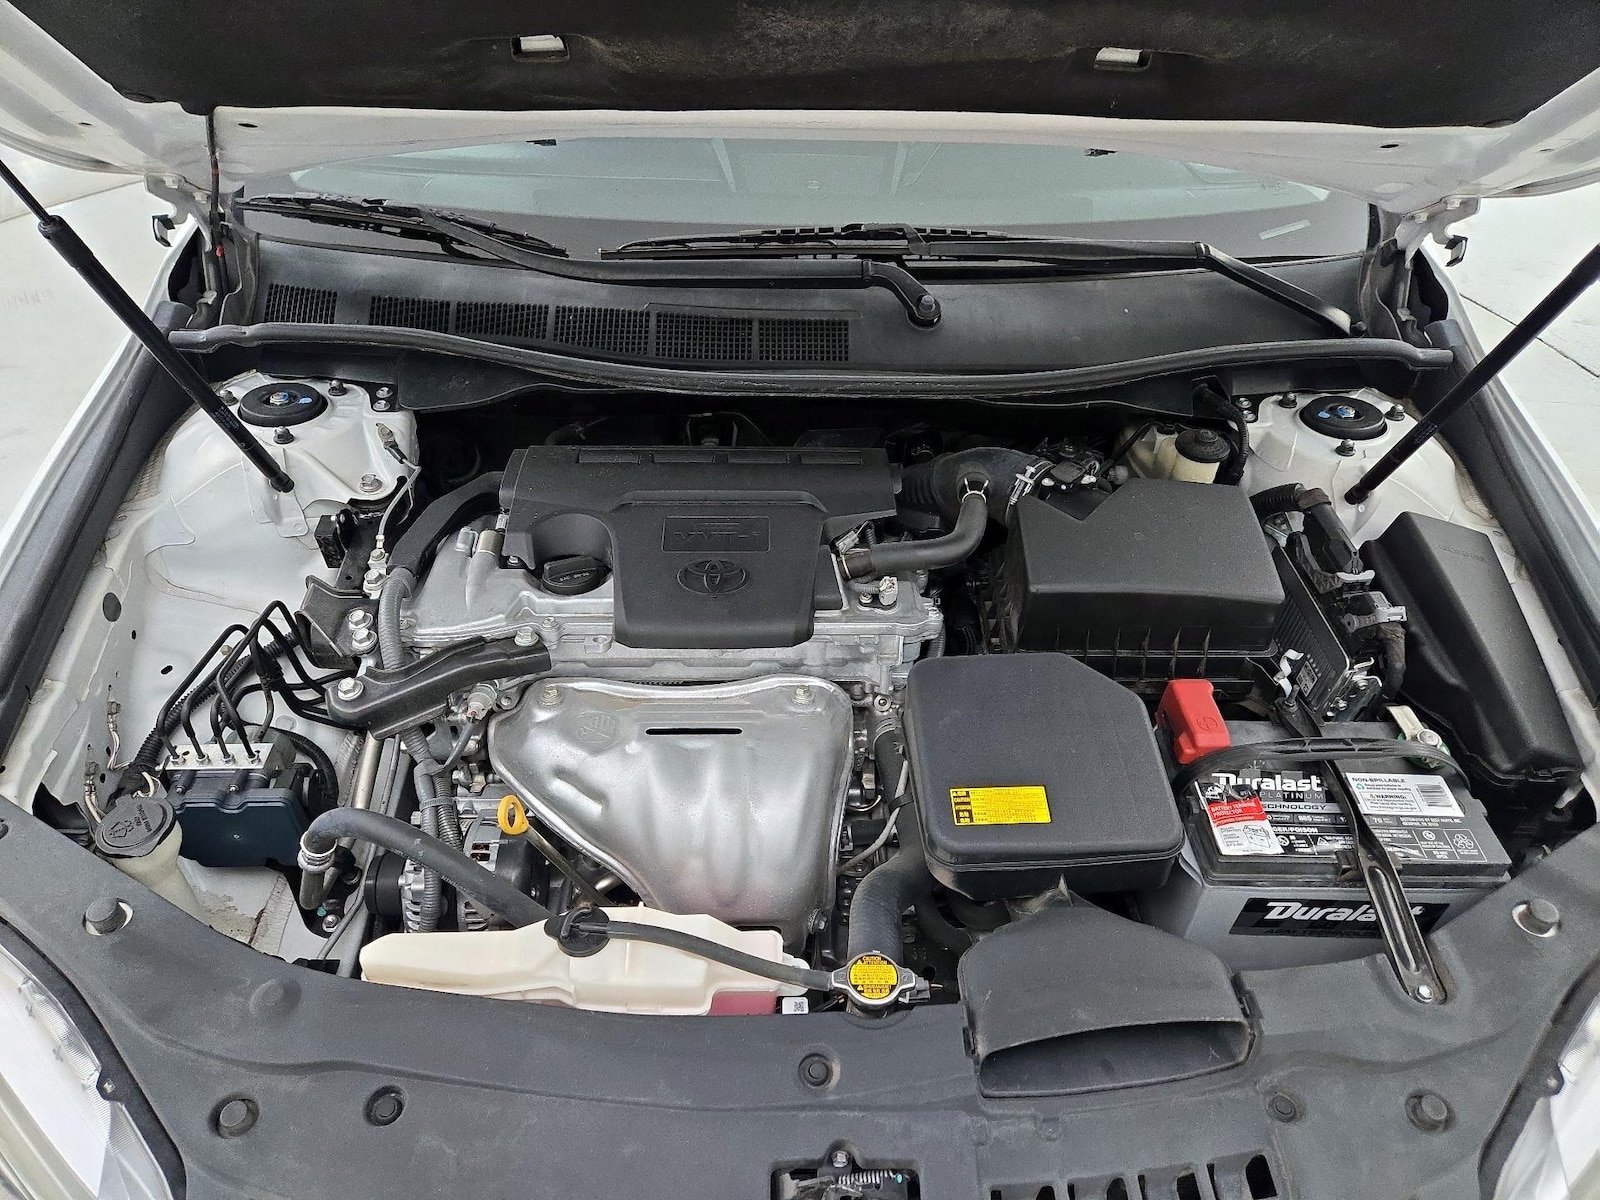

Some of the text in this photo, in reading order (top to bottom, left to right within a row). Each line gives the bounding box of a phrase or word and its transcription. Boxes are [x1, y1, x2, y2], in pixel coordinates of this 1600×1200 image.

[1259, 791, 1324, 800] PLATINUM
[1263, 803, 1326, 811] ECHNOLOGY
[1263, 901, 1425, 922] Duralat
